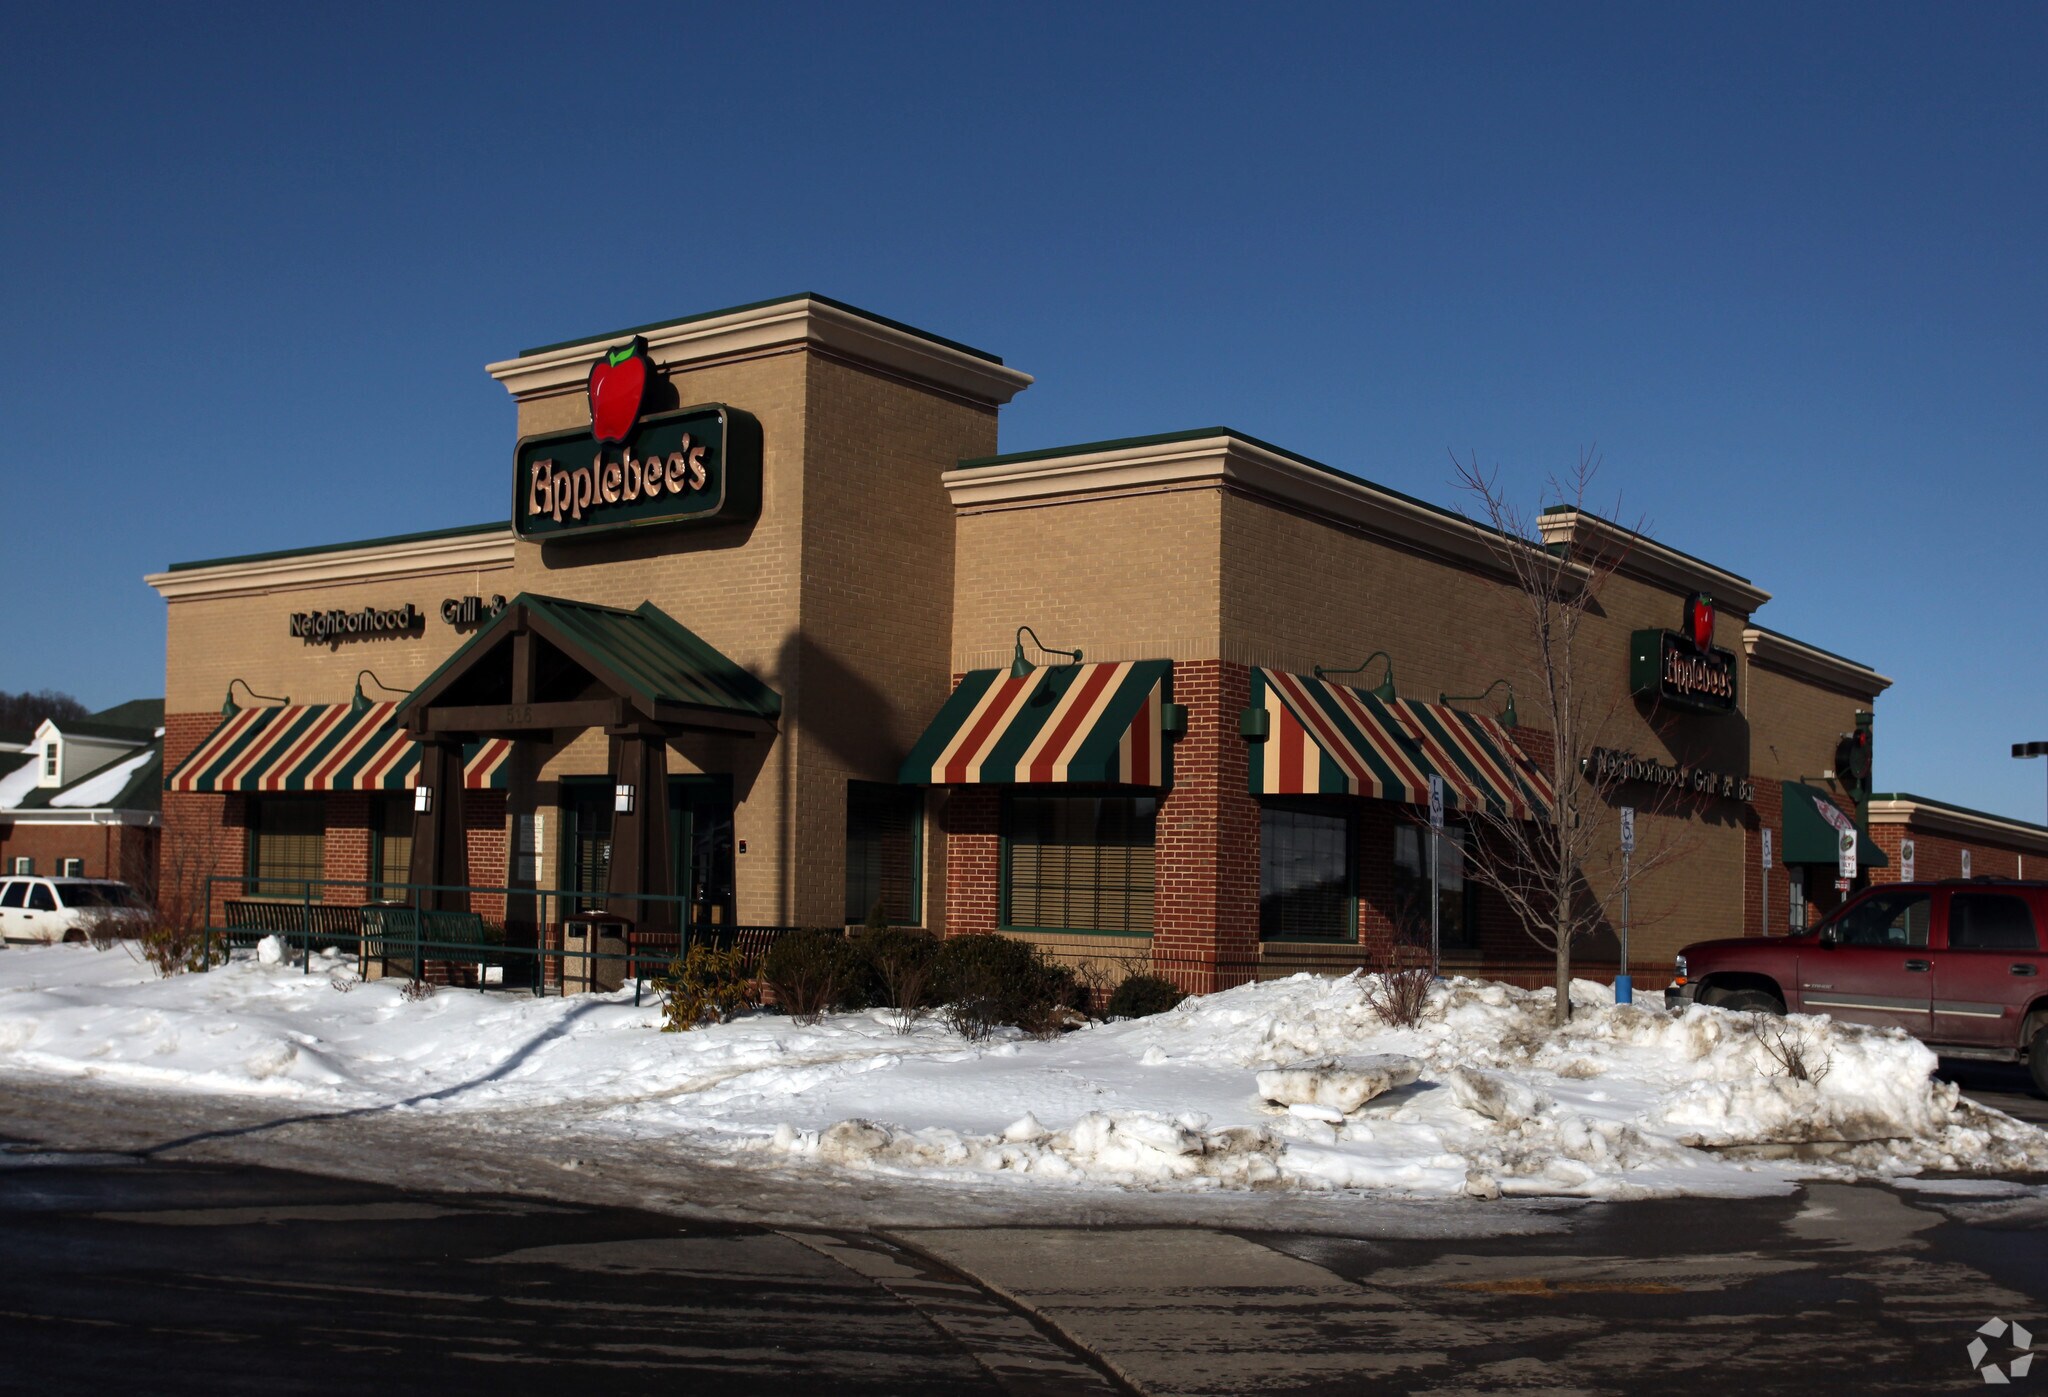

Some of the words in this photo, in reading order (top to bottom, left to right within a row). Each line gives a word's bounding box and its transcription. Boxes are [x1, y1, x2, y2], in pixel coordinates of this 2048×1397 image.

[527, 431, 707, 523] Applebee's
[290, 603, 416, 641] Neighborhood
[441, 596, 481, 625] Grill
[491, 594, 506, 618] &
[1666, 648, 1733, 699] Applebee's
[1694, 768, 1715, 794] Grill
